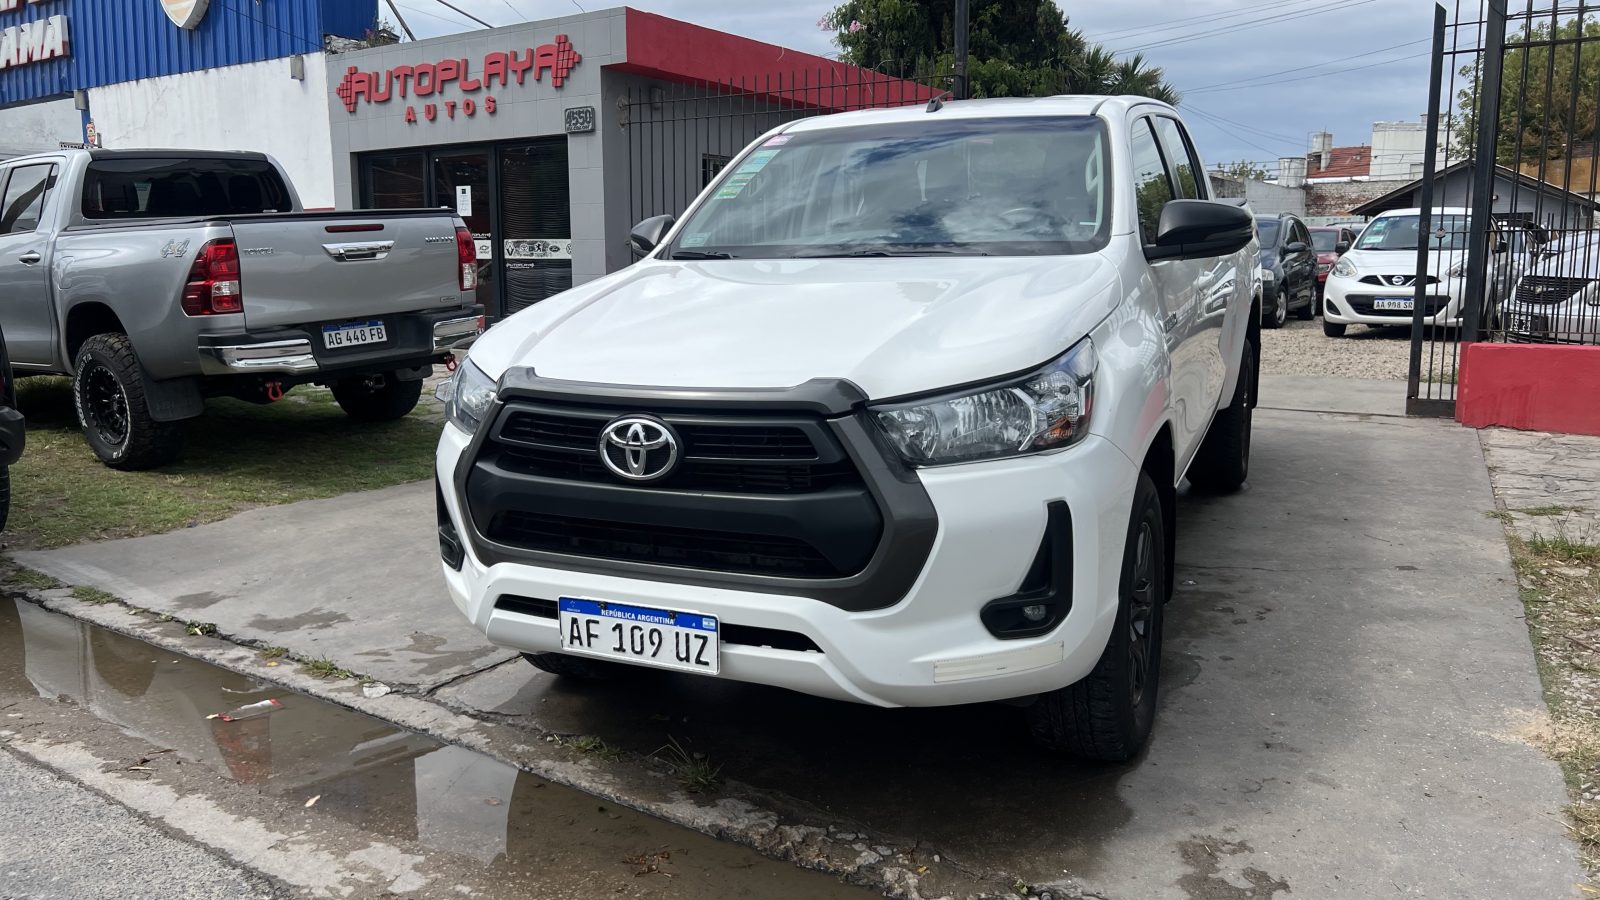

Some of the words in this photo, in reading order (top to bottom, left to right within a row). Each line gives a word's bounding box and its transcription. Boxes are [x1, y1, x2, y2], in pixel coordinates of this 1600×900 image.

[350, 43, 559, 104] AUTOPLAYA
[405, 96, 497, 123] AUTOS
[328, 332, 343, 346] AG
[346, 329, 367, 344] 448
[369, 327, 384, 341] FB
[601, 608, 636, 620] REPÚBLICA
[637, 613, 675, 625] ARGENTINA
[569, 617, 600, 647] AF
[611, 623, 663, 658] 109
[675, 631, 710, 666] UZ
